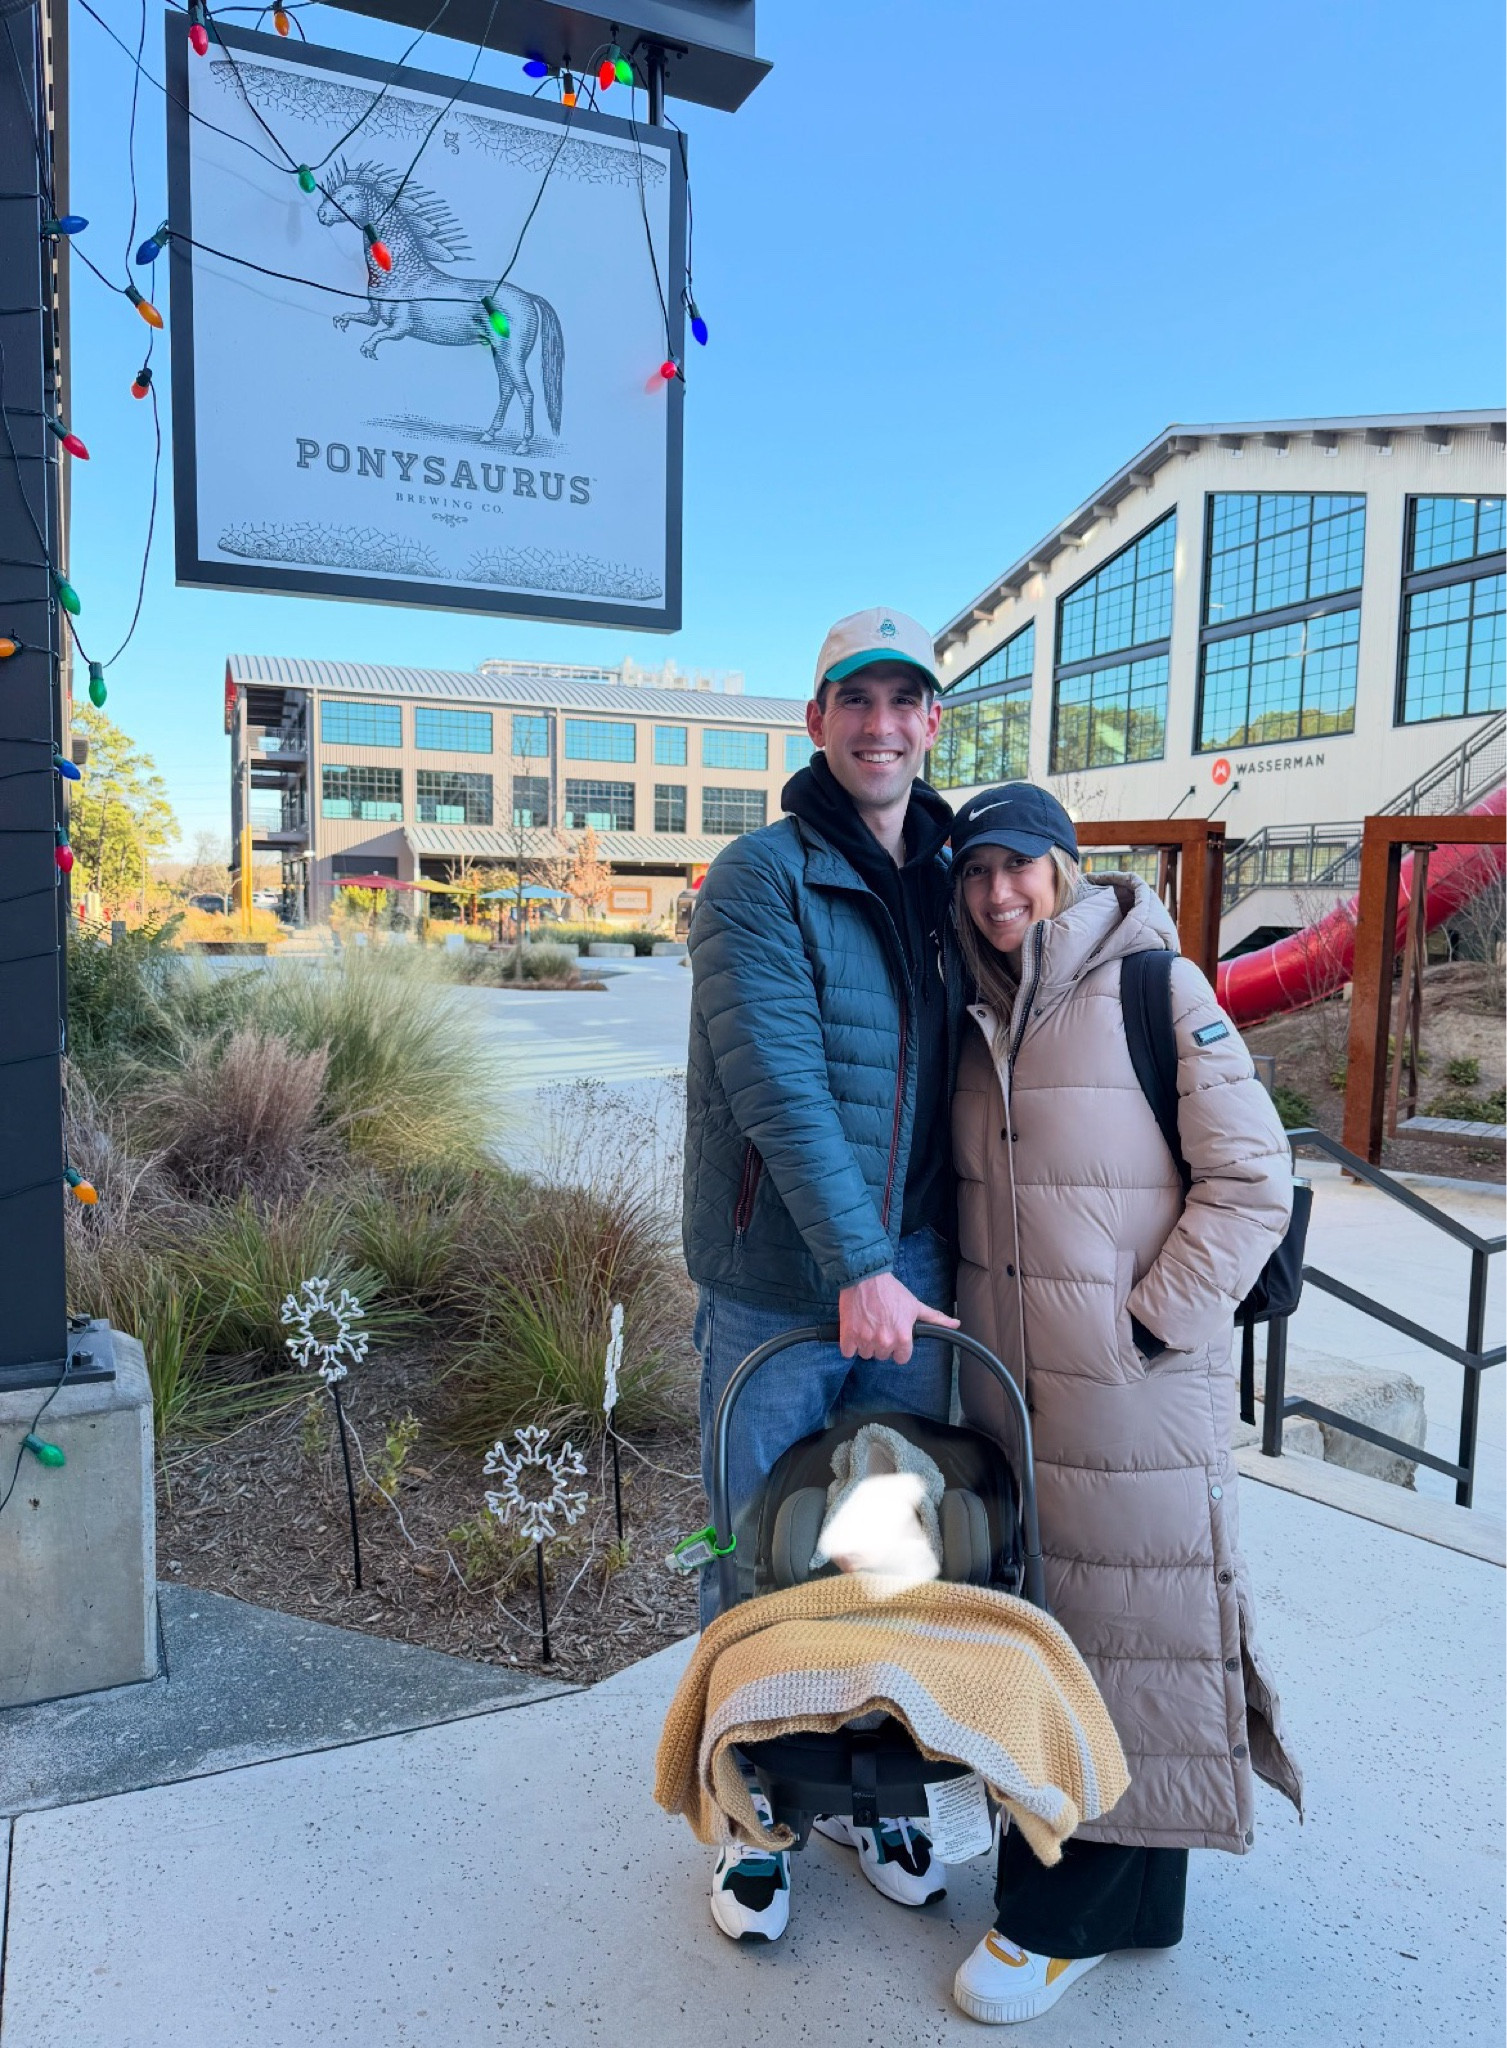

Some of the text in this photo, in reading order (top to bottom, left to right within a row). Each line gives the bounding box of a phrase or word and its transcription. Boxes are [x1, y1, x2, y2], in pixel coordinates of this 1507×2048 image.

[296, 437, 590, 505] PONYSAURUS
[396, 492, 504, 514] BREWING CO.
[1236, 754, 1325, 775] WASSERMAN
